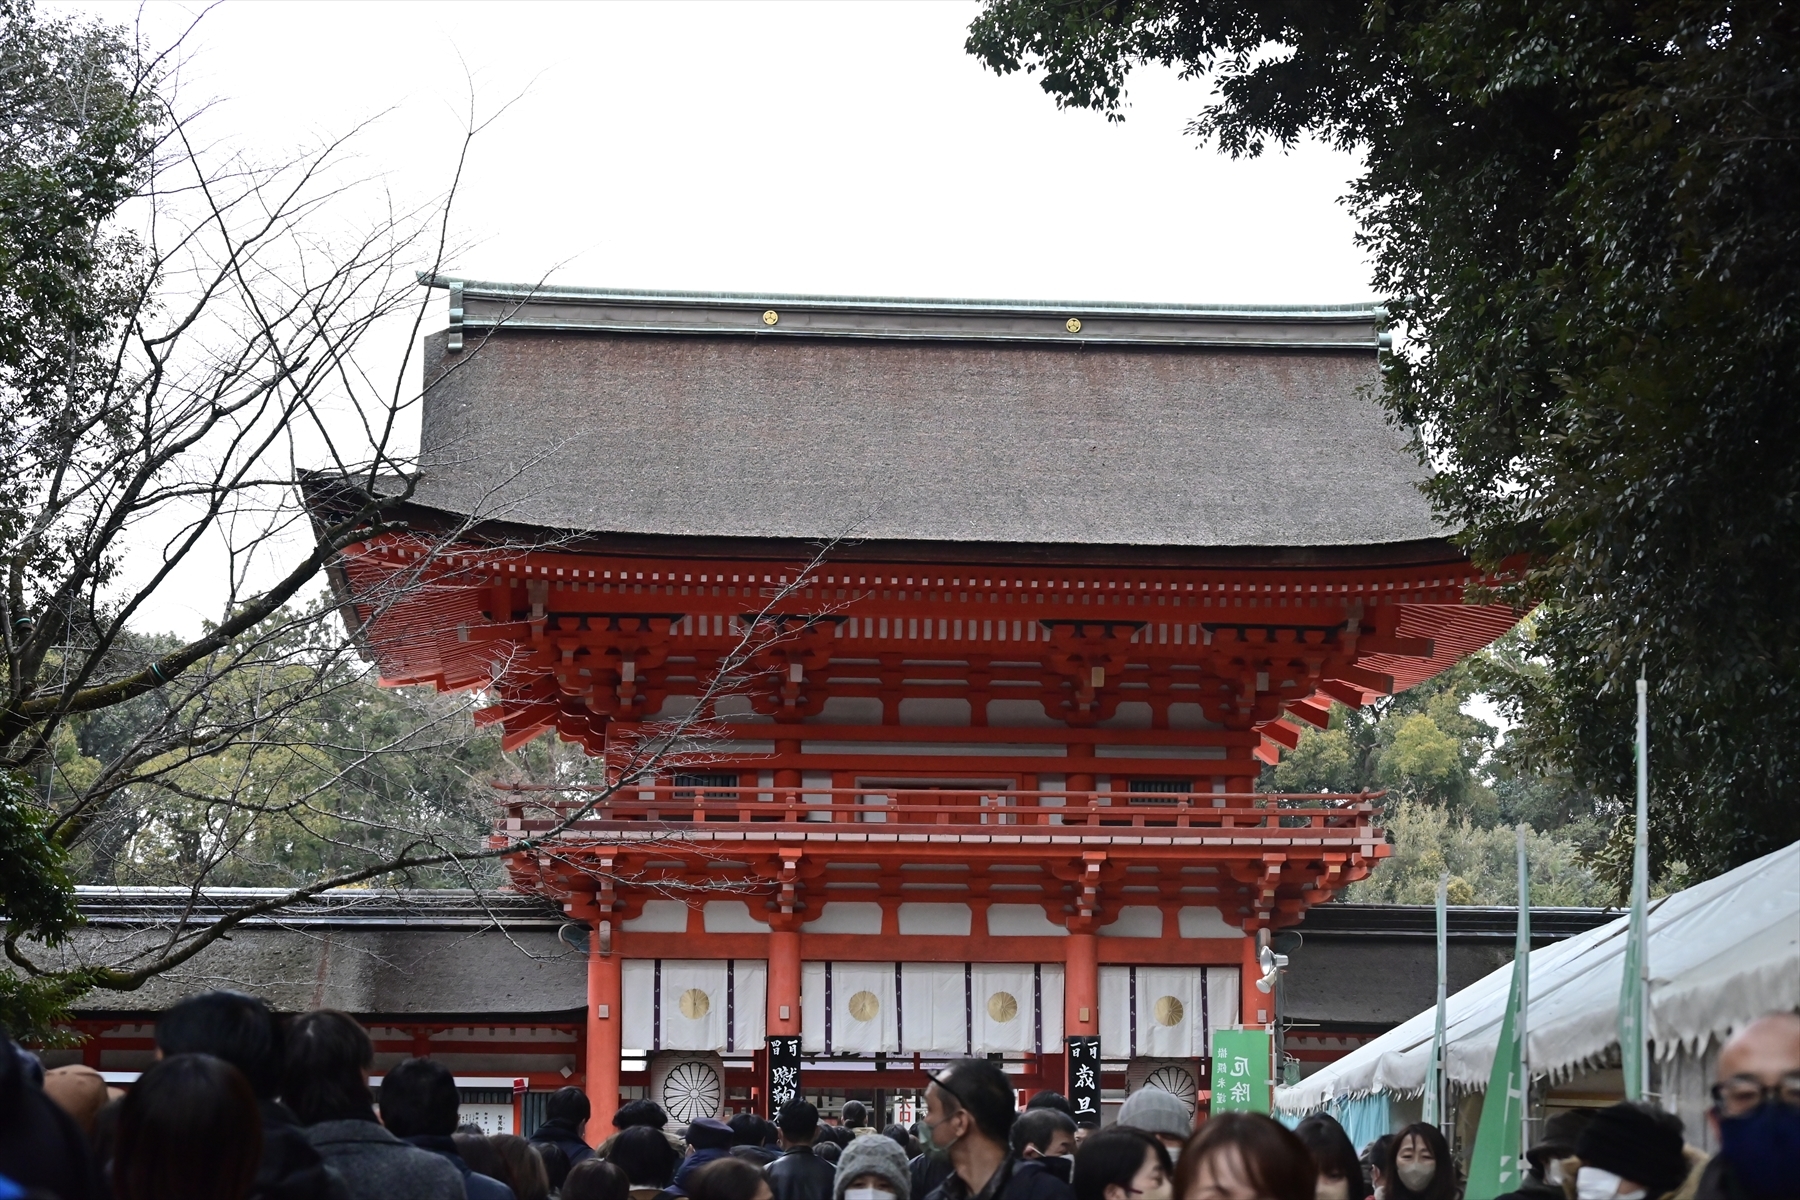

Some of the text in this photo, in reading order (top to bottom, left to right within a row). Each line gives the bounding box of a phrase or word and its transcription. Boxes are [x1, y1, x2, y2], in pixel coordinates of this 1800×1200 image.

[787, 1039, 798, 1057] 一月
[1070, 1042, 1081, 1058] 一日
[1087, 1041, 1099, 1059] 一月
[1074, 1063, 1096, 1124] 歳旦
